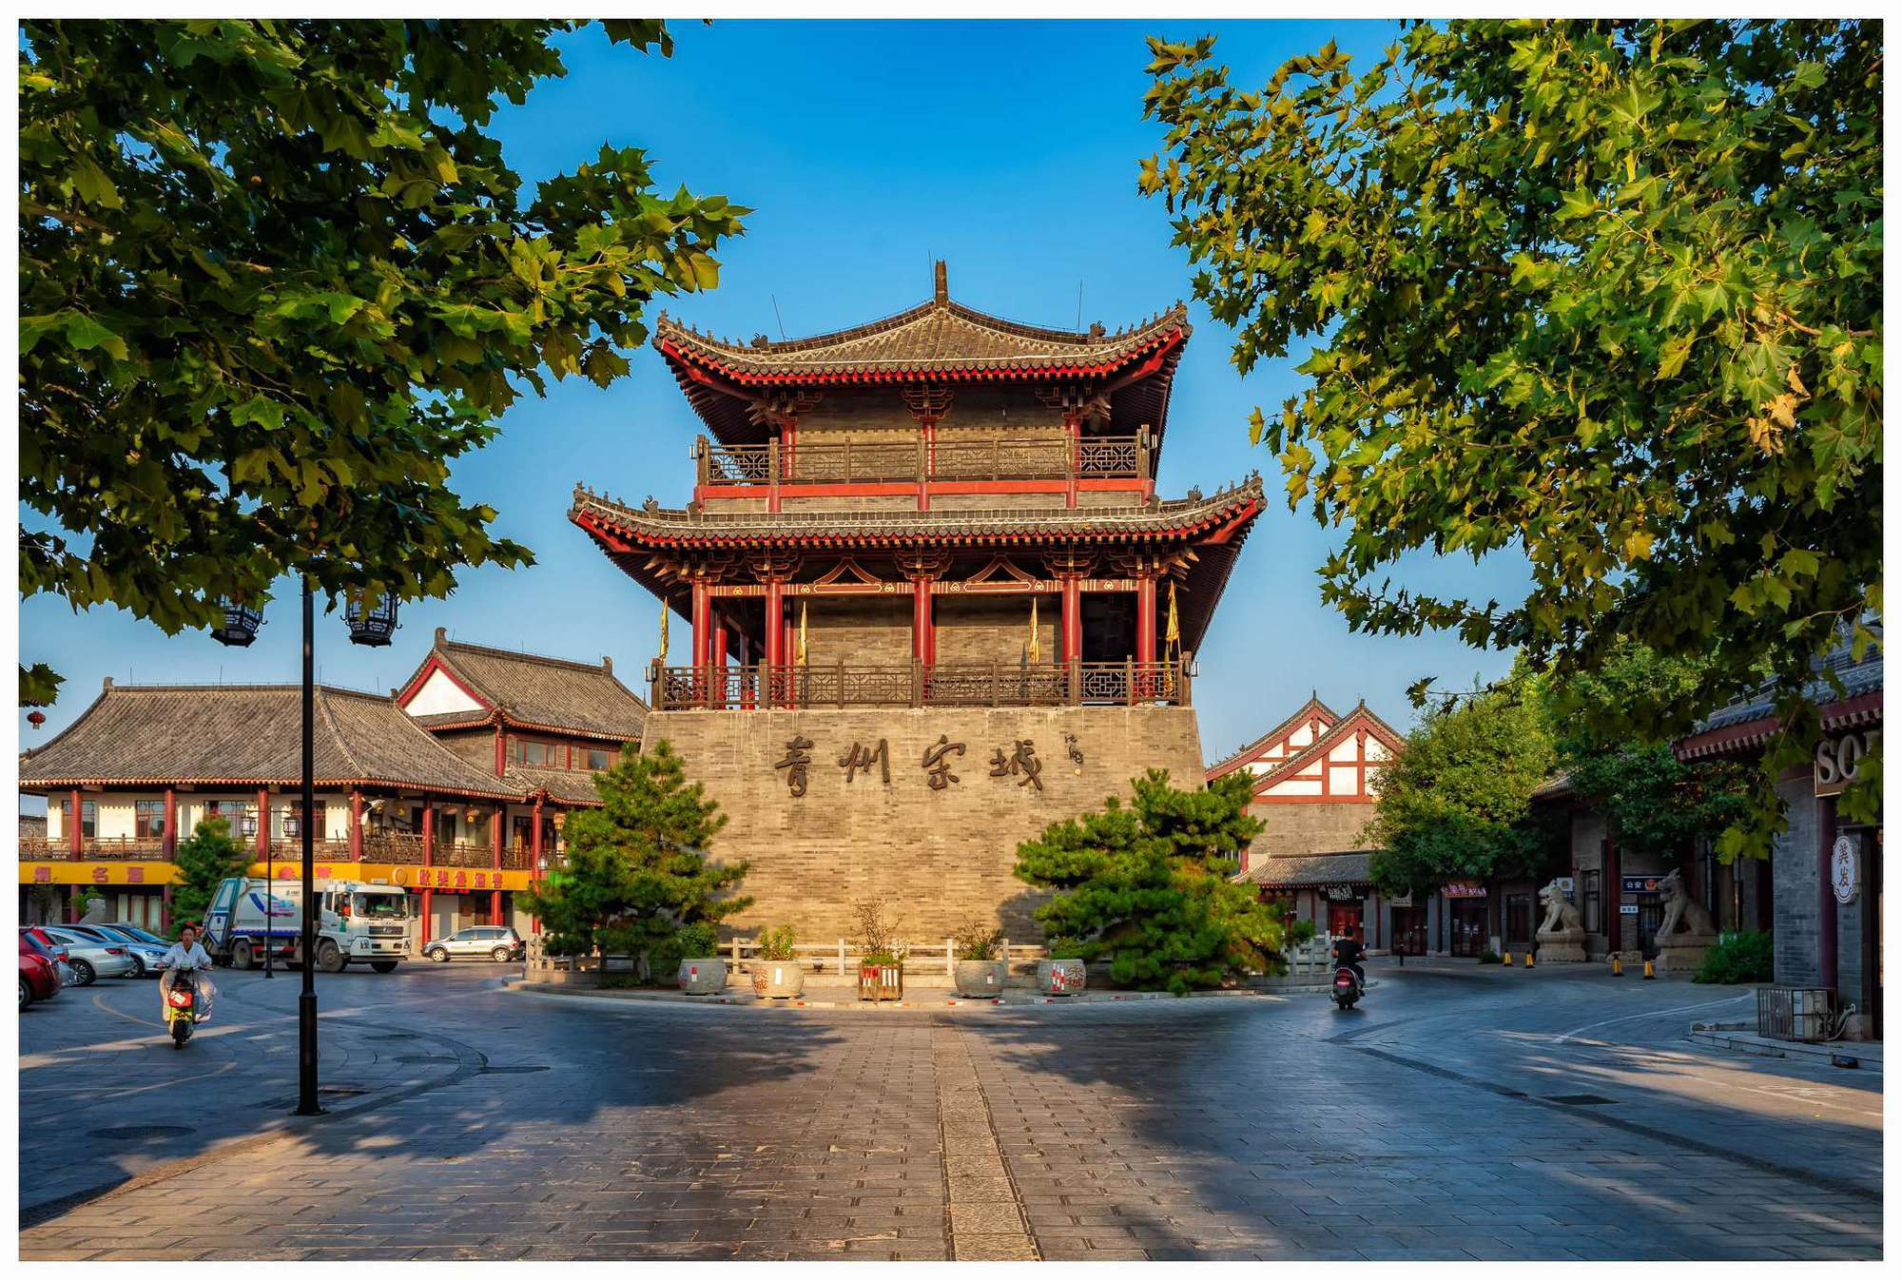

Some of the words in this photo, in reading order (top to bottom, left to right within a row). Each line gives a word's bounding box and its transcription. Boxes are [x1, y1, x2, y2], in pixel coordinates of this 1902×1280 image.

[774, 735, 1043, 797] 青州宋城
[1816, 732, 1883, 784] SO
[1838, 843, 1850, 887] 美发
